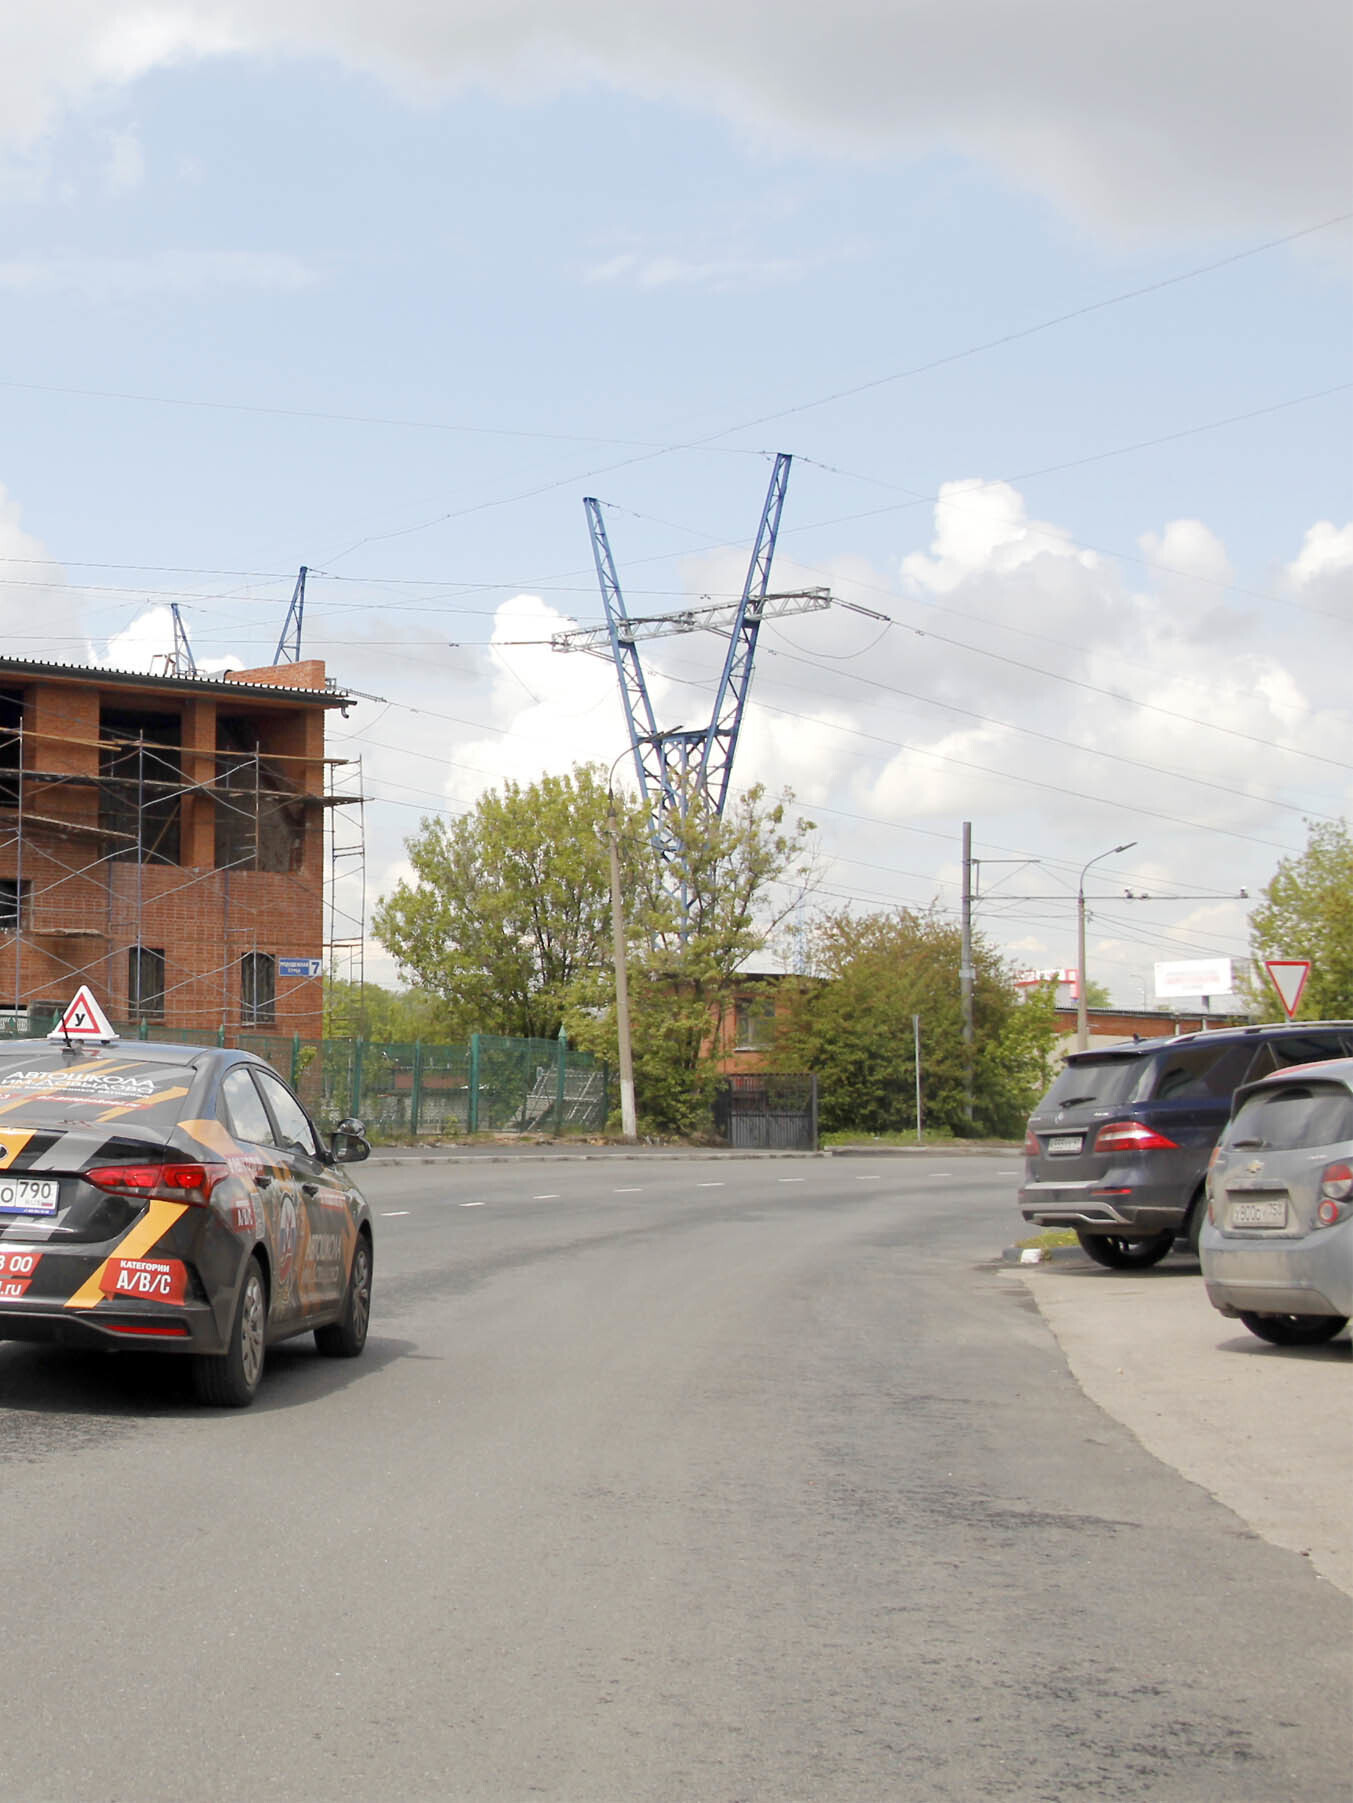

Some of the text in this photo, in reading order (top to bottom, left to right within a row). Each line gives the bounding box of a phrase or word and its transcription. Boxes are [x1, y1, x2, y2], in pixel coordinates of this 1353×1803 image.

[311, 961, 320, 975] 7
[75, 1013, 86, 1027] У
[4, 1071, 156, 1089] АВТОШКОЛА
[9, 1256, 33, 1273] 00
[120, 1260, 170, 1273] КАТЕГОРИИ
